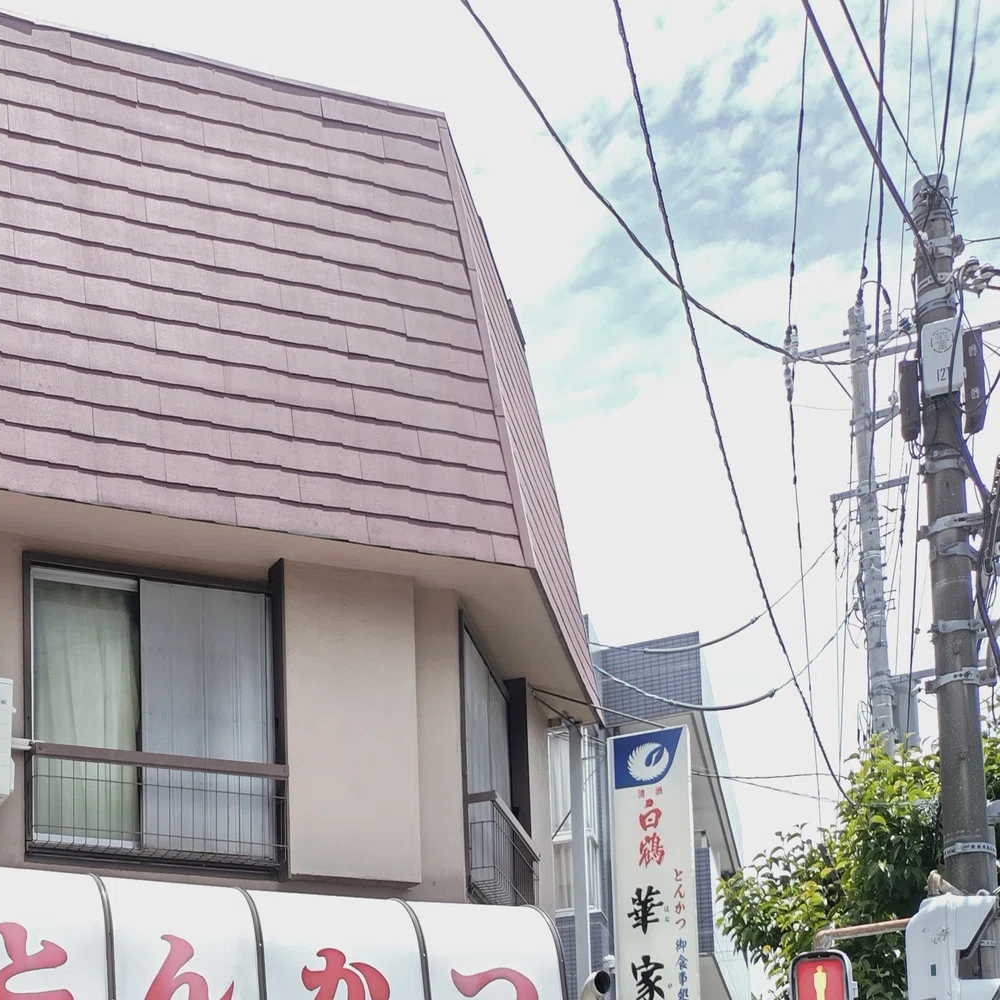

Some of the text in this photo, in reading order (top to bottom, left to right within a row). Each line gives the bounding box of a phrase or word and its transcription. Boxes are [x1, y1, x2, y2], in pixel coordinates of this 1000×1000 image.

[638, 799, 665, 868] 白鶴
[673, 868, 686, 930] とんかつ
